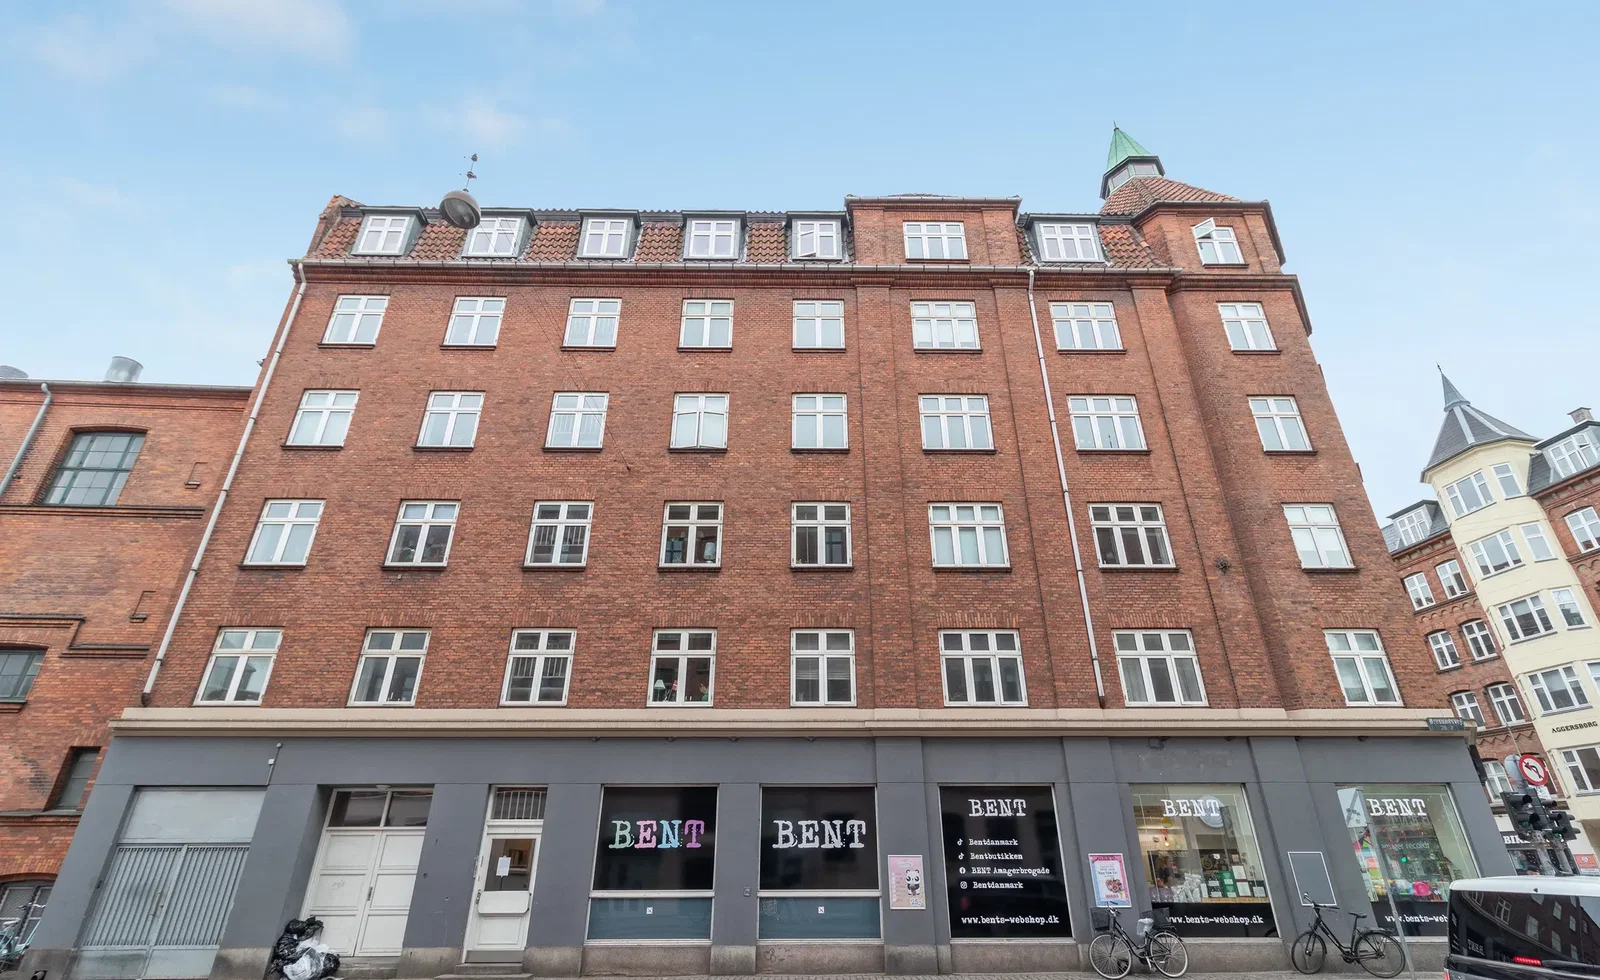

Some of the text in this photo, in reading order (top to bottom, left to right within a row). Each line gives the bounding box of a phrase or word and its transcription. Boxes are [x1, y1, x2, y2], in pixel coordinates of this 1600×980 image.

[1552, 721, 1598, 733] AGGERSBORG
[968, 799, 1026, 816] BENT
[1161, 799, 1220, 816] BENT
[1366, 799, 1427, 816] BENT
[609, 819, 705, 848] BENT
[772, 819, 866, 848] BENT
[1503, 835, 1532, 844] BIK
[993, 867, 1050, 877] Amagerbrogade
[973, 881, 1024, 889] Bentdanmark
[961, 915, 1060, 925] www.bents-webshop.dk
[1166, 915, 1264, 925] www.bents-webshop.dk
